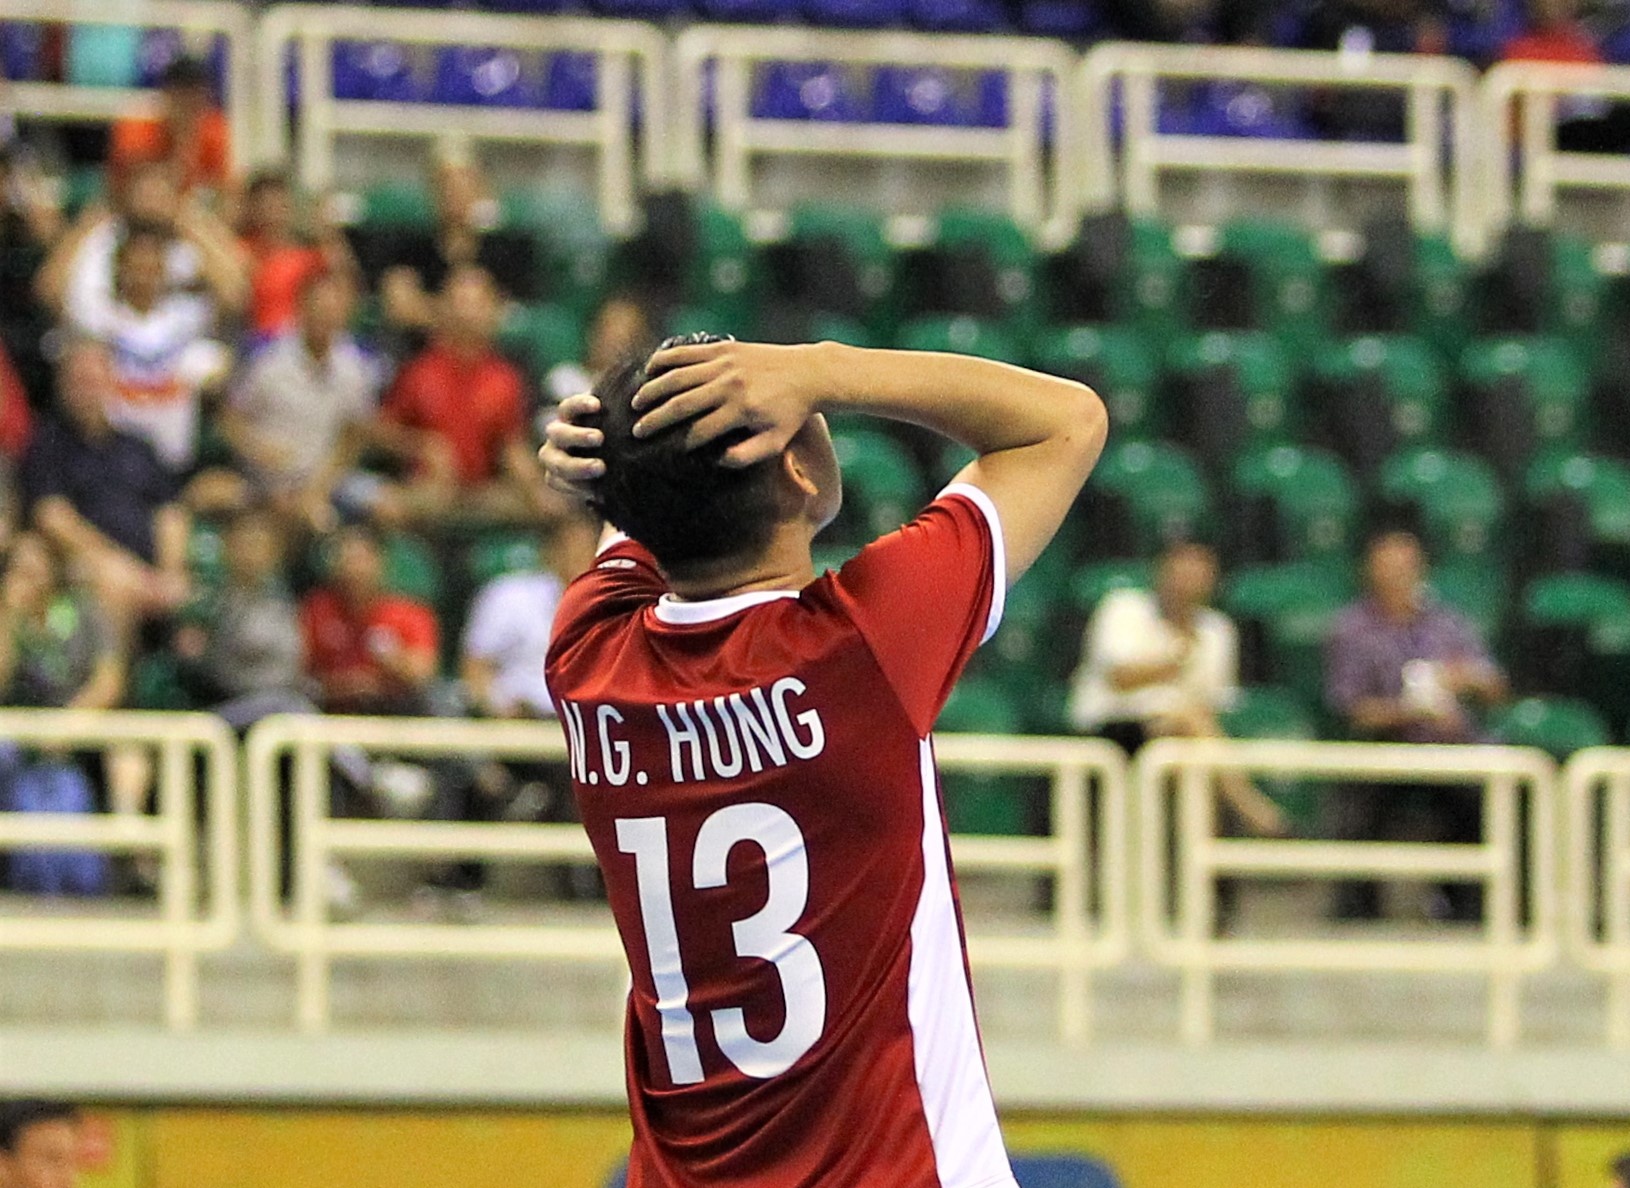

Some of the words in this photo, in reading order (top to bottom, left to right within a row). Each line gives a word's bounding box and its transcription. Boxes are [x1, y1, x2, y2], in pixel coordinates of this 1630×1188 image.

[560, 698, 649, 787] N.G.
[656, 676, 826, 783] HUNG
[614, 801, 827, 1085] 13
